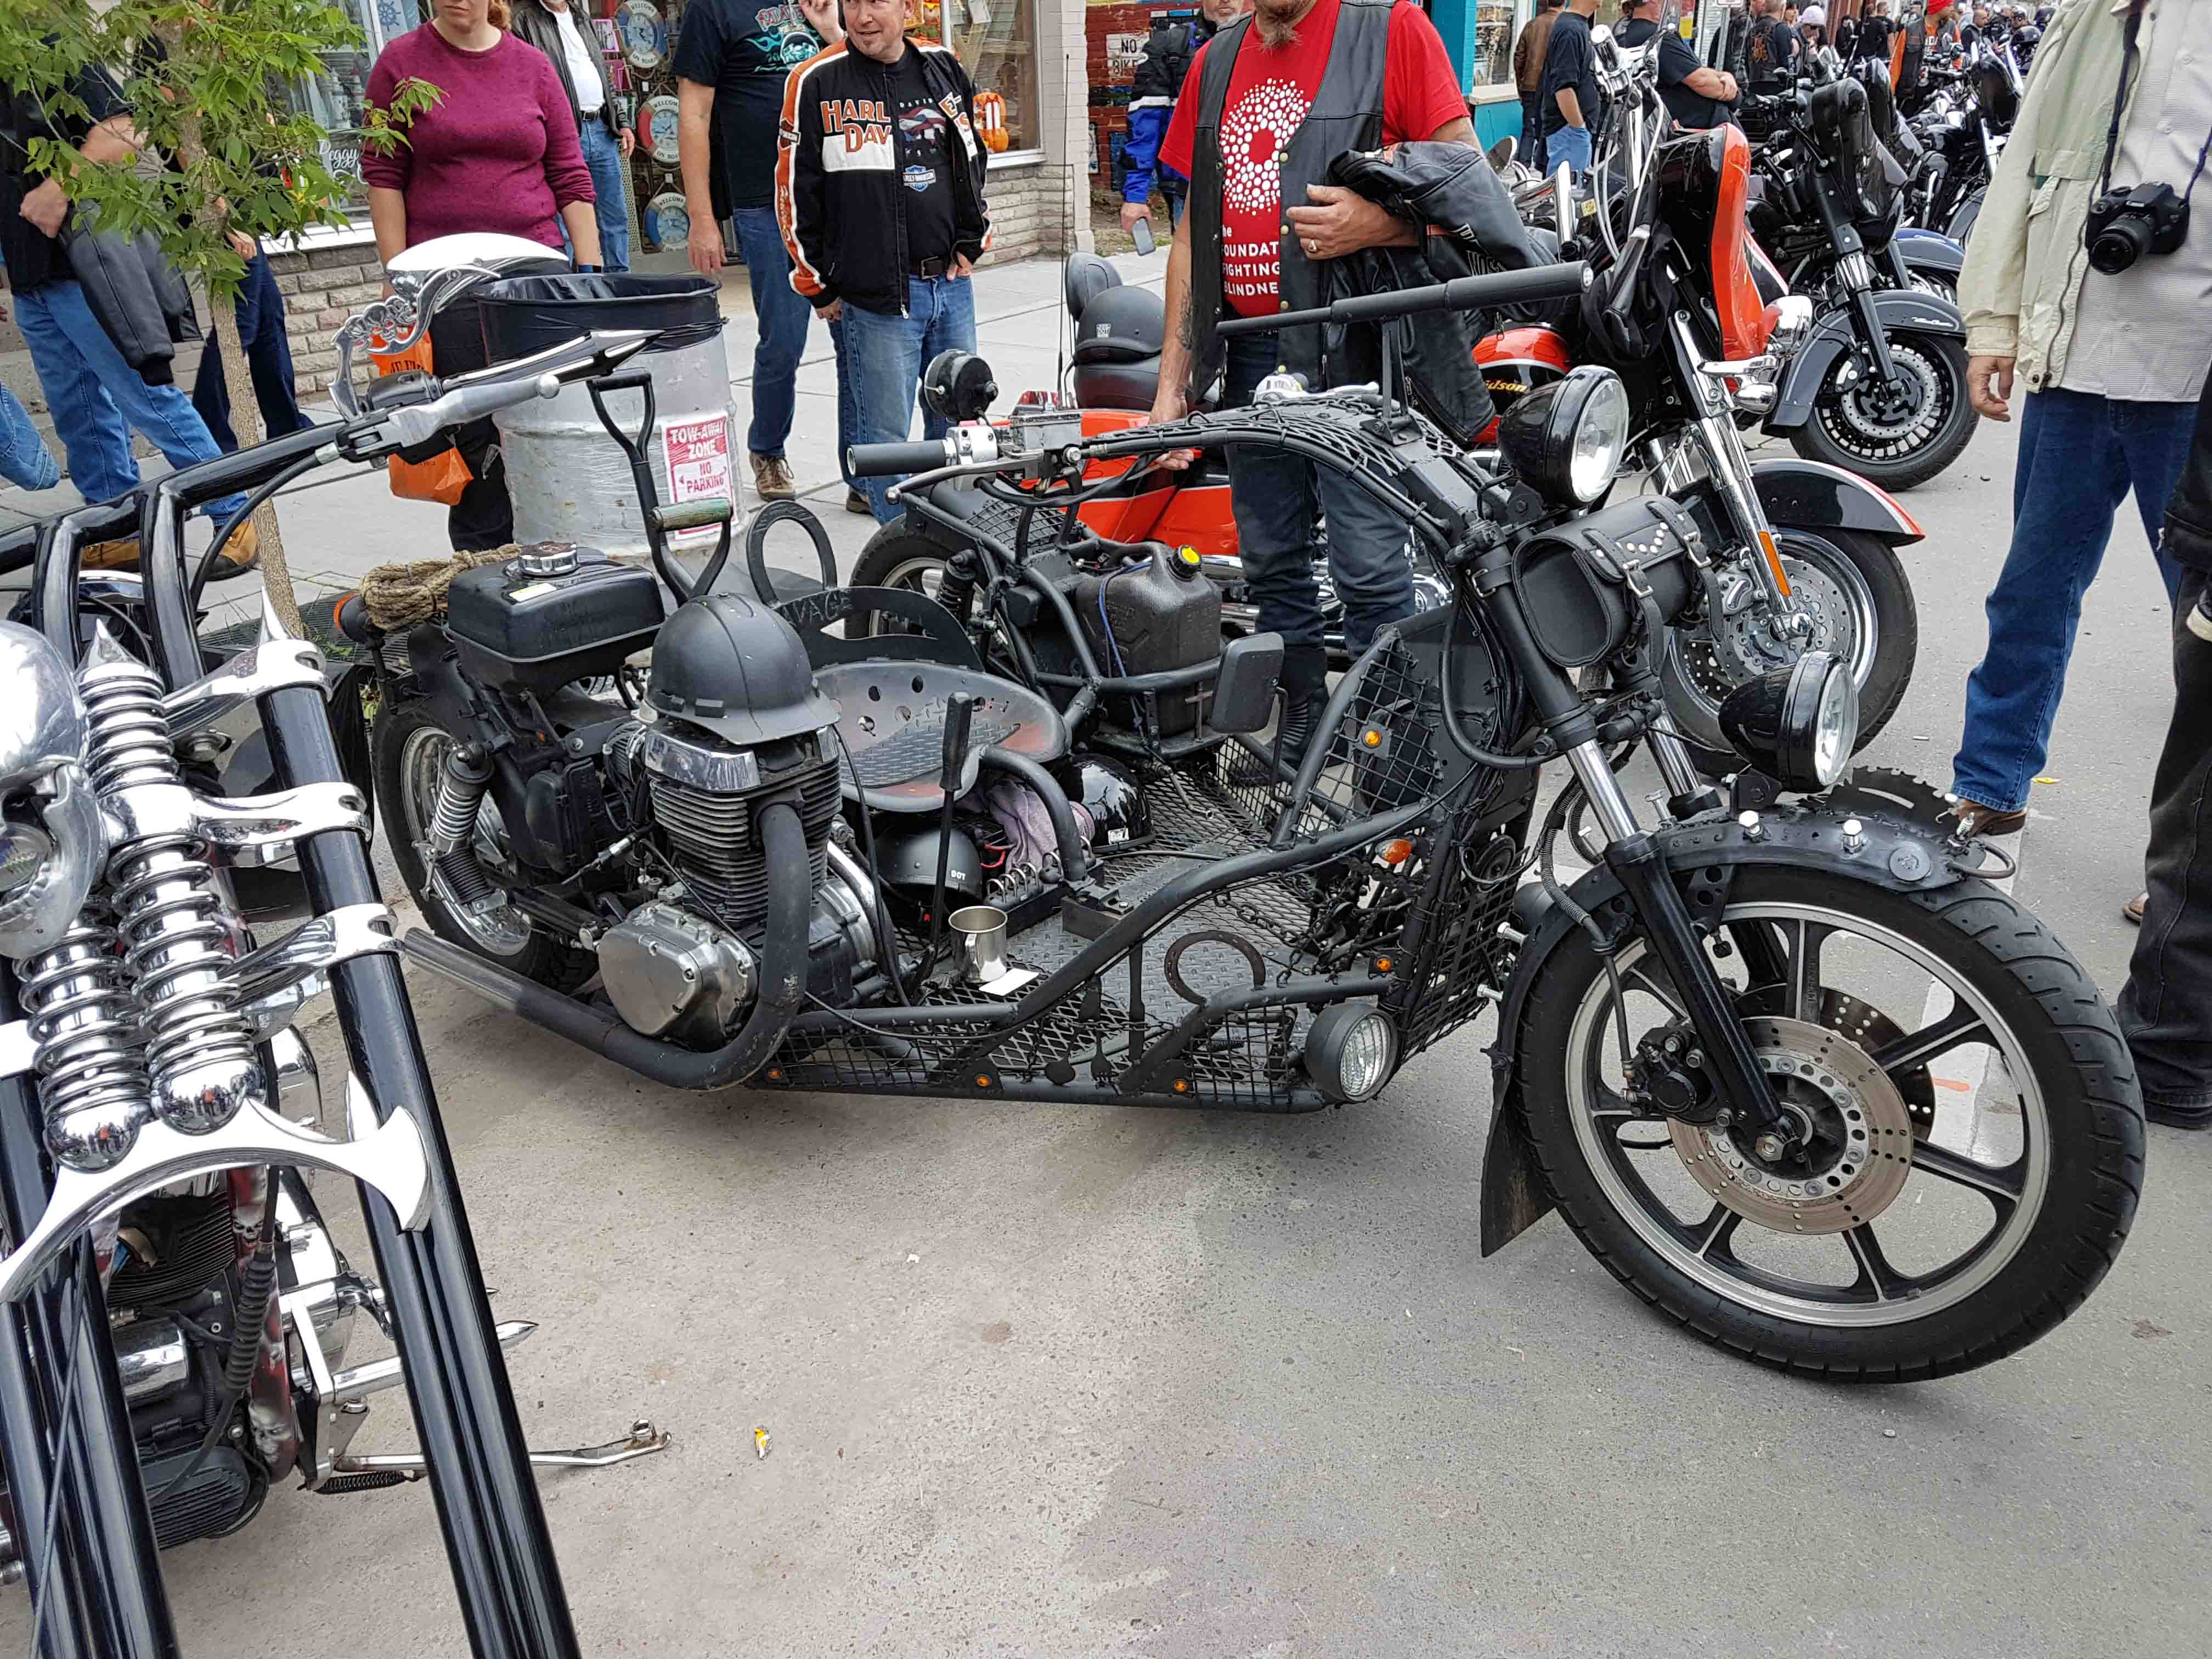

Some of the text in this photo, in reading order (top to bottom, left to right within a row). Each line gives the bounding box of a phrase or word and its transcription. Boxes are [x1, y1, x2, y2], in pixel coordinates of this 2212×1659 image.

[1121, 39, 1137, 53] NO
[821, 99, 891, 133] HARL
[842, 122, 892, 153] DAV
[1222, 224, 1232, 237] he
[1222, 241, 1279, 257] OUNDAT
[670, 420, 724, 444] TOW-AWAY
[687, 439, 716, 460] ZONE
[699, 461, 712, 476] NO
[687, 475, 724, 493] PARKING
[951, 870, 966, 881] DOT
